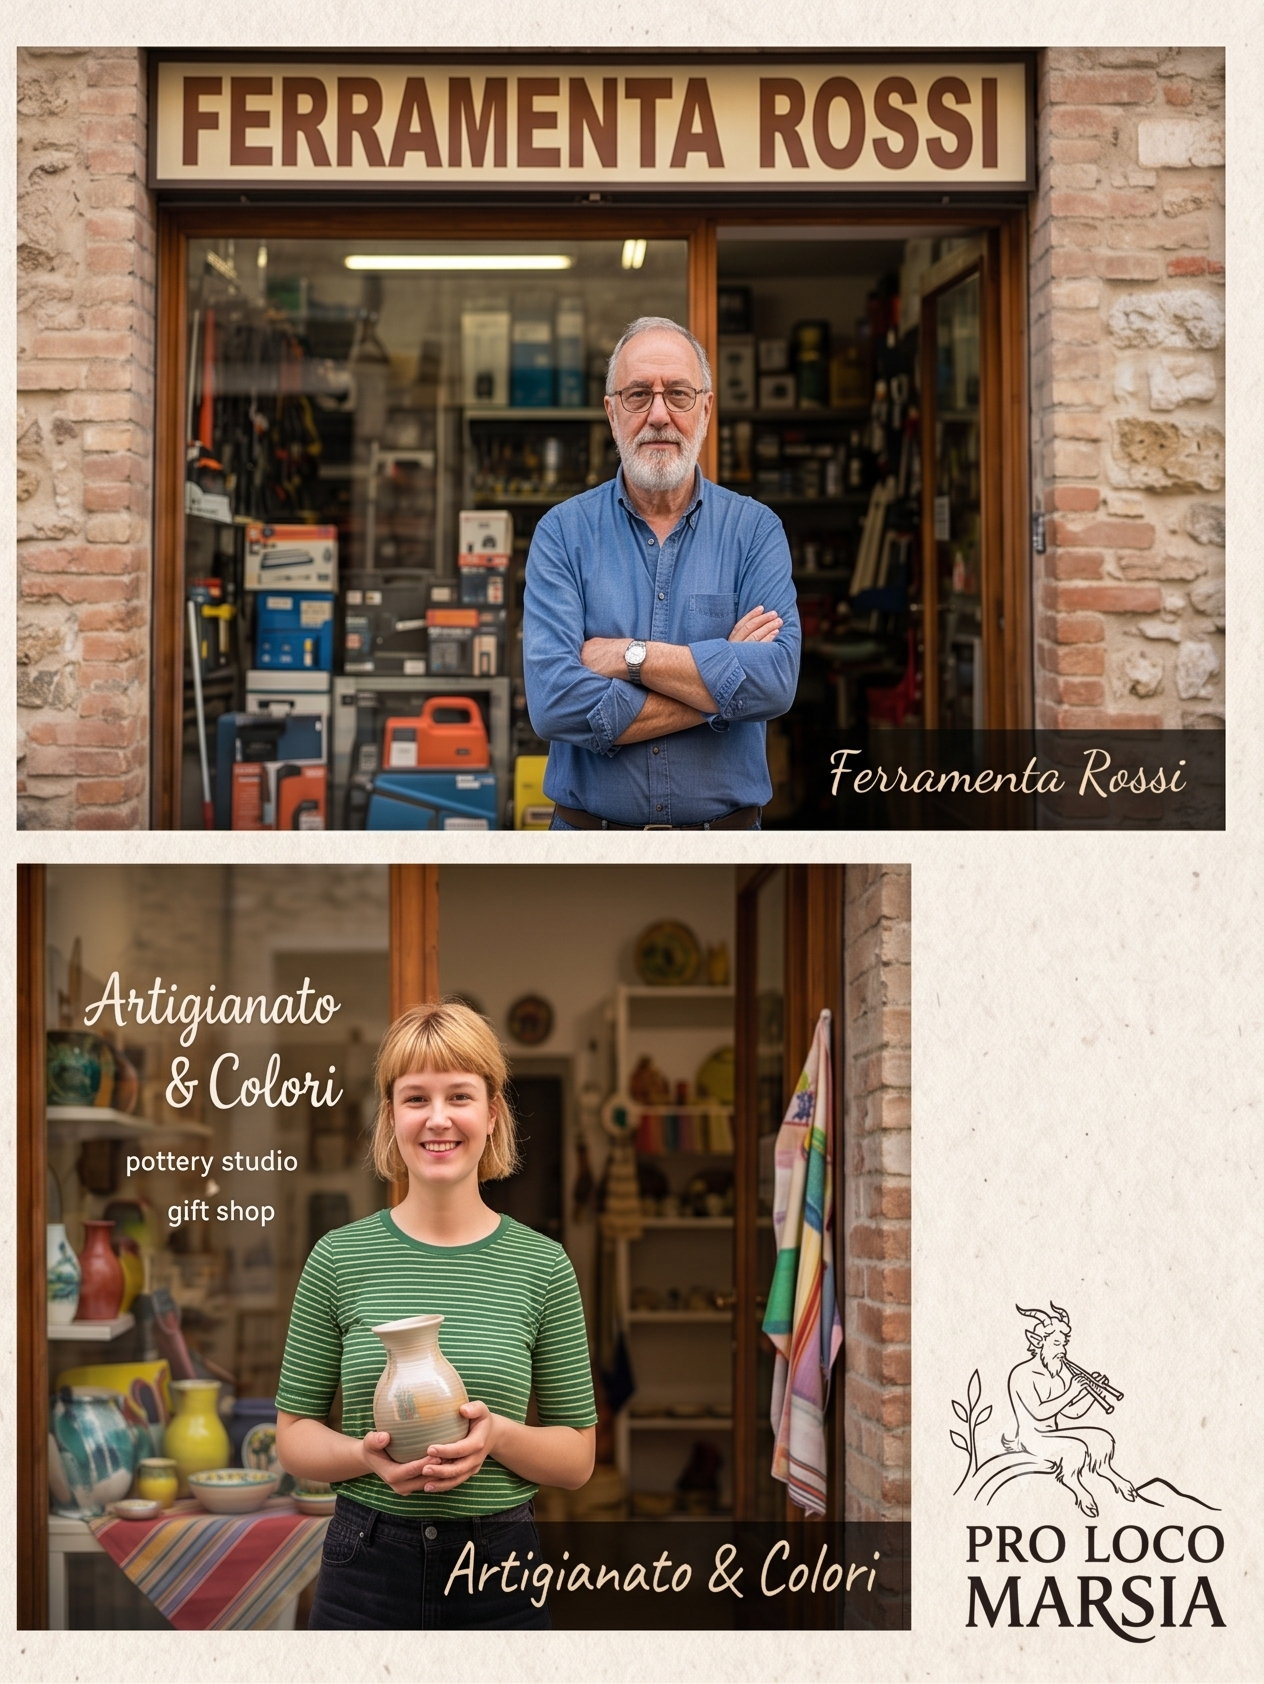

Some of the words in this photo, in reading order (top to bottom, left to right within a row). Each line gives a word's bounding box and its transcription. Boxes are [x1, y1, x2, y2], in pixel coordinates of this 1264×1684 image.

[182, 75, 726, 169] FERRAMENTA
[759, 75, 999, 170] ROSSI
[83, 970, 342, 1048] Artigianato
[165, 1056, 200, 1109] &
[209, 1051, 344, 1111] Colori
[125, 1150, 214, 1178] pottery
[221, 1149, 299, 1173] studio
[167, 1199, 210, 1228] gift
[216, 1199, 276, 1228] shop
